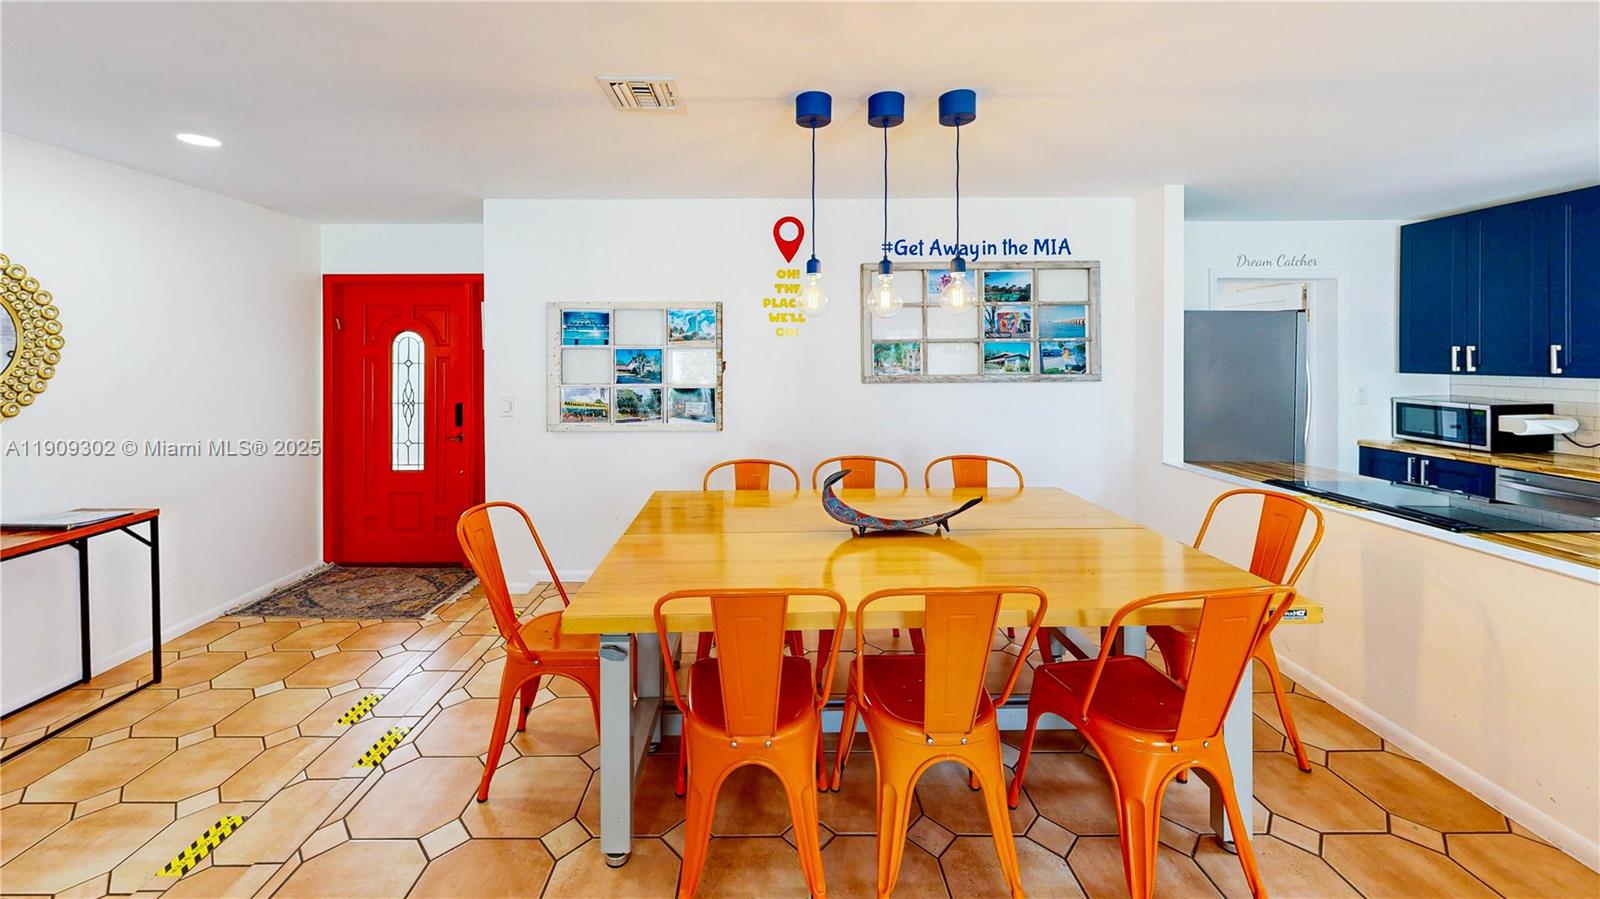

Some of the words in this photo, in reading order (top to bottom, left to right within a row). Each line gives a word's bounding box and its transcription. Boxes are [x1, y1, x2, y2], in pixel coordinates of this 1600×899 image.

[881, 239, 924, 256] #Get
[929, 239, 979, 262] Away
[982, 240, 997, 256] in
[1002, 239, 1028, 256] the
[1033, 238, 1072, 256] MIA
[1236, 254, 1273, 268] Dream
[1276, 253, 1318, 268] Catcher
[776, 269, 801, 279] OH!
[762, 298, 806, 308] PLAC
